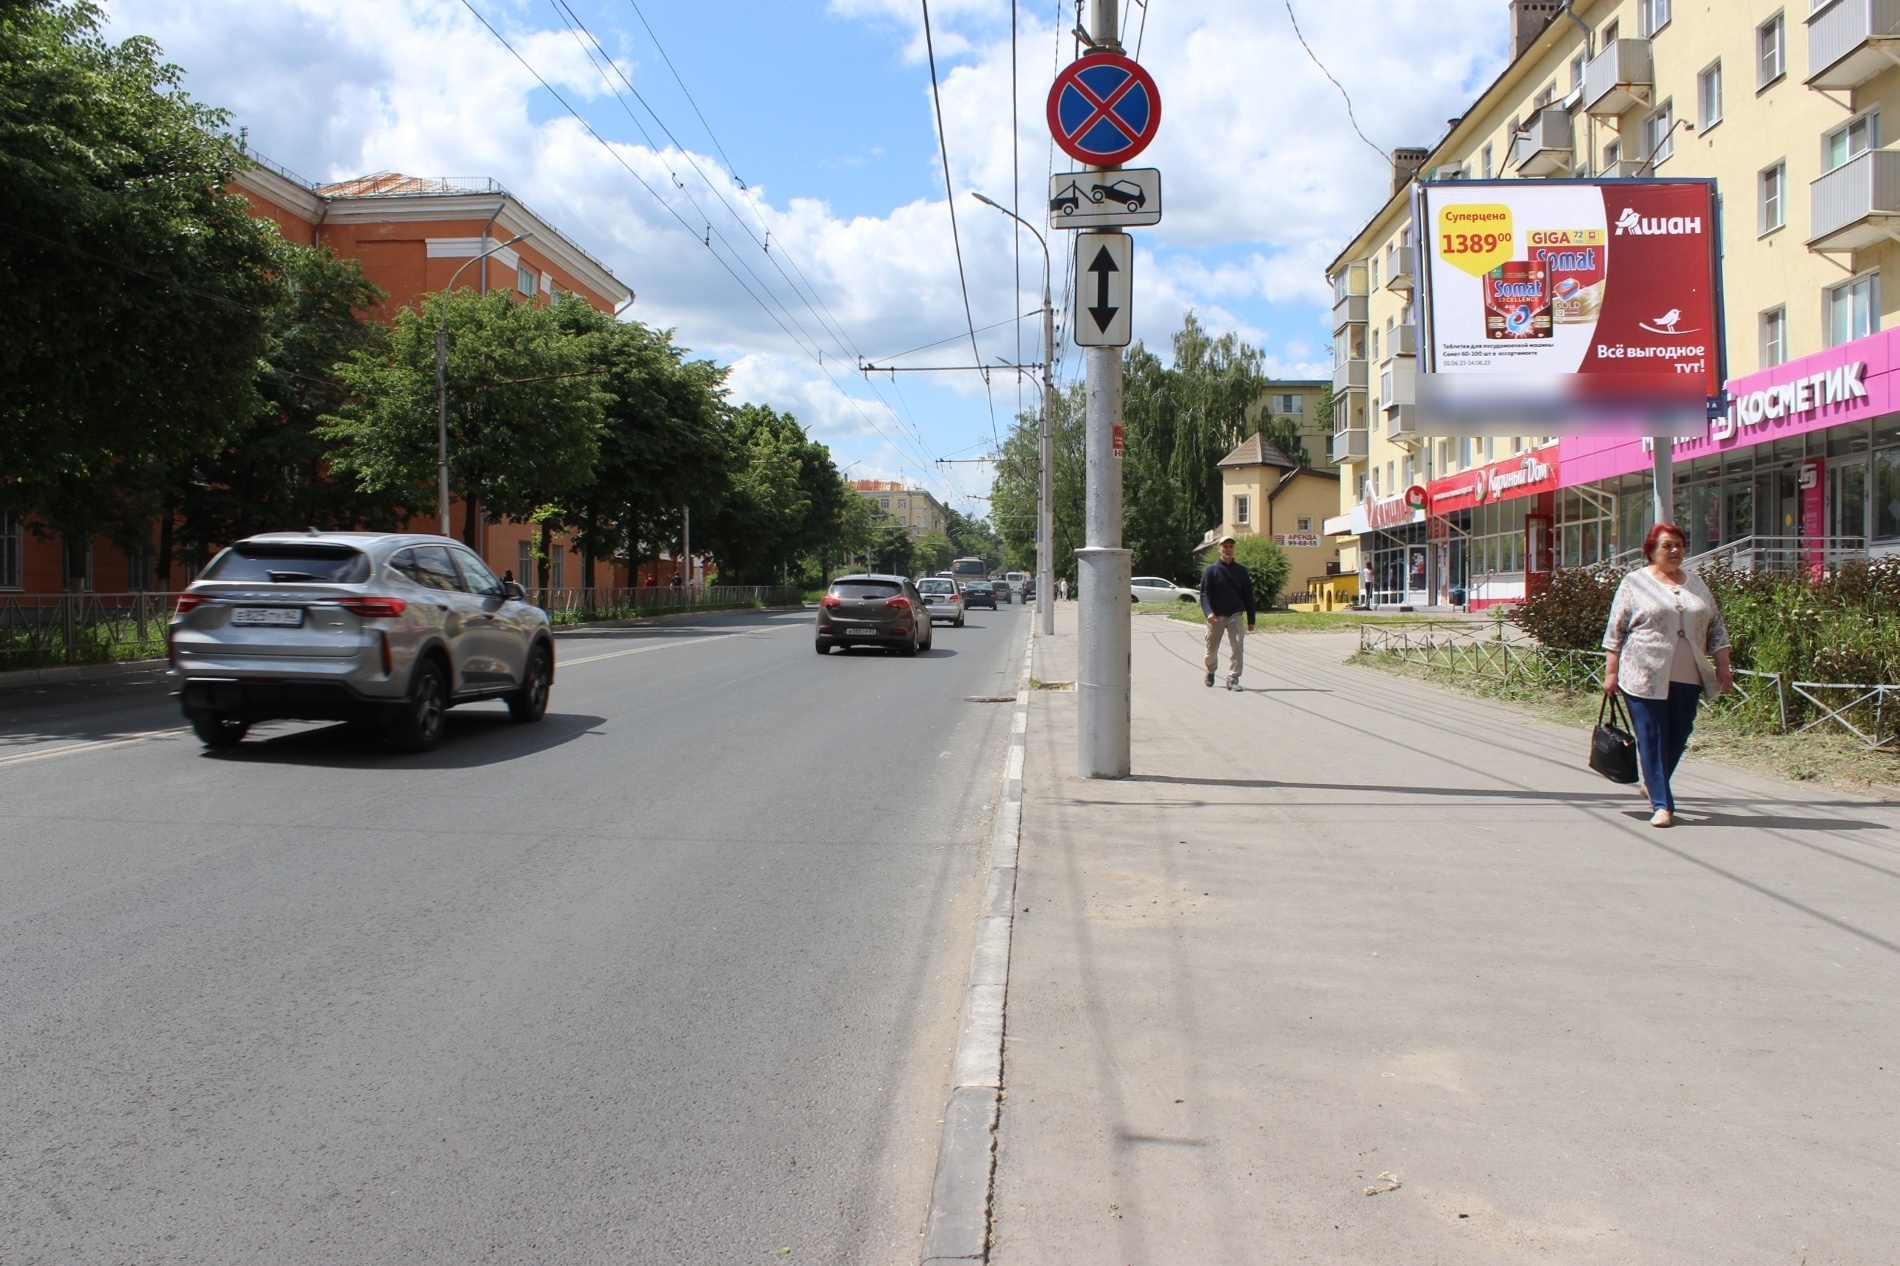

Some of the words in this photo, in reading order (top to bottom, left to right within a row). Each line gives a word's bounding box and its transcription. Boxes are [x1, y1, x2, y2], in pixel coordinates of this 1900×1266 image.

[1445, 211, 1506, 223] Суперцена
[1614, 208, 1701, 236] Ашан
[1531, 232, 1571, 244] GIGA
[1537, 248, 1595, 271] Somat
[1494, 280, 1542, 297] Somat
[1597, 344, 1624, 359] Всё
[1626, 345, 1705, 359] выгодное
[1736, 362, 1868, 428] КОСМЕТИК
[1527, 458, 1550, 482] Дом
